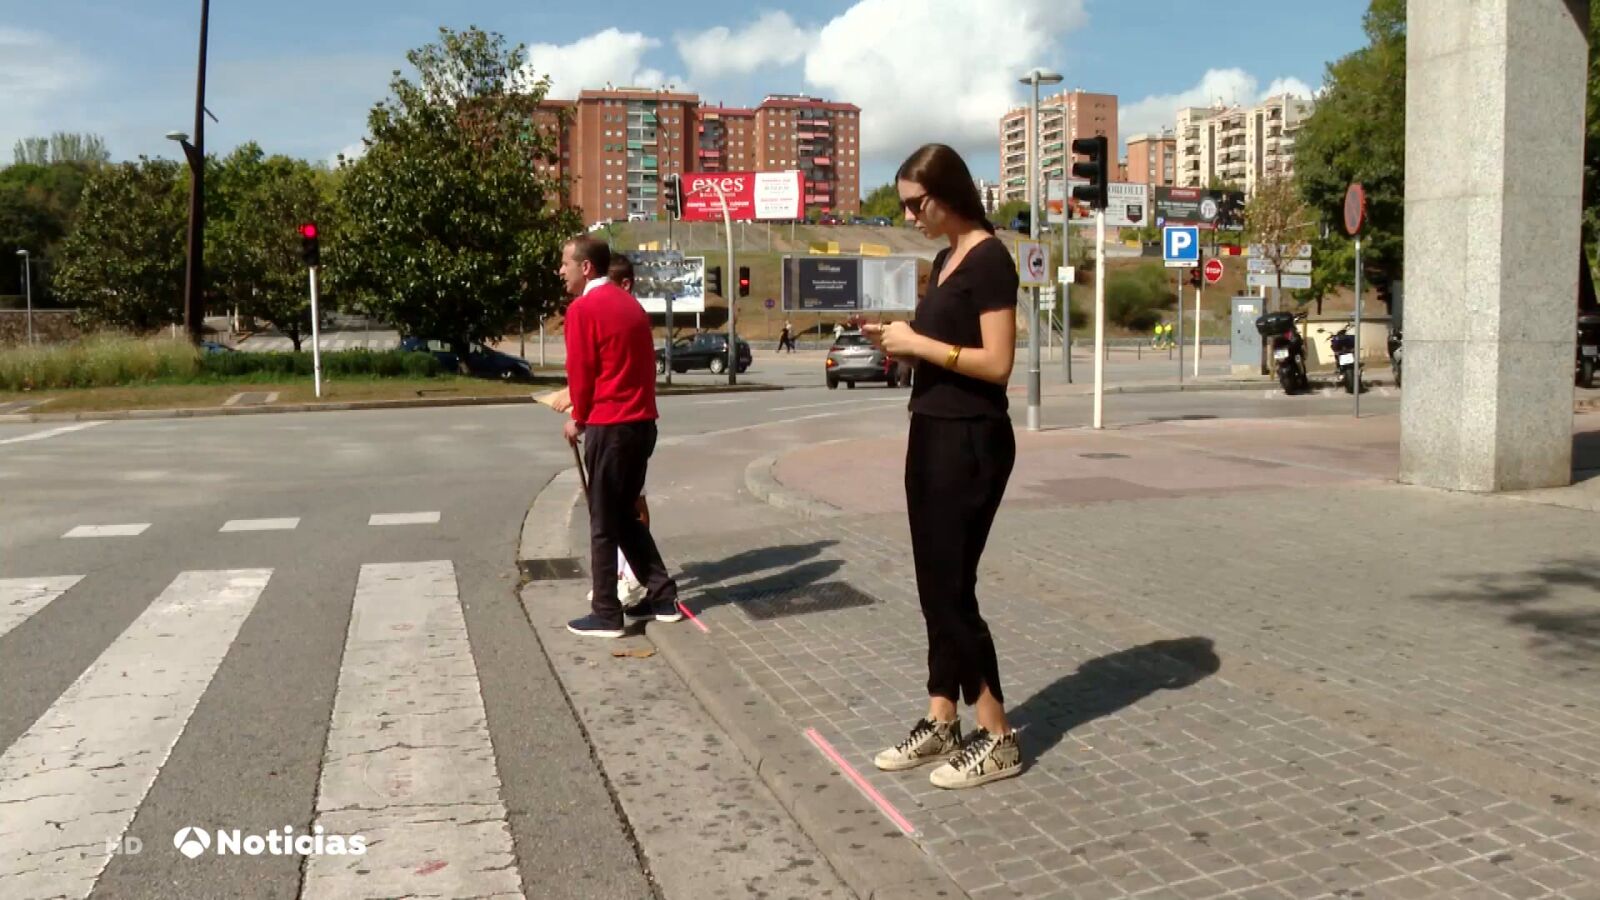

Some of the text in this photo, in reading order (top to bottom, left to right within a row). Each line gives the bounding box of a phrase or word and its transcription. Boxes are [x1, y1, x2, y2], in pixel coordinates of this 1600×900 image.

[692, 177, 744, 193] exes
[1171, 231, 1191, 256] P
[1206, 266, 1221, 274] STOP
